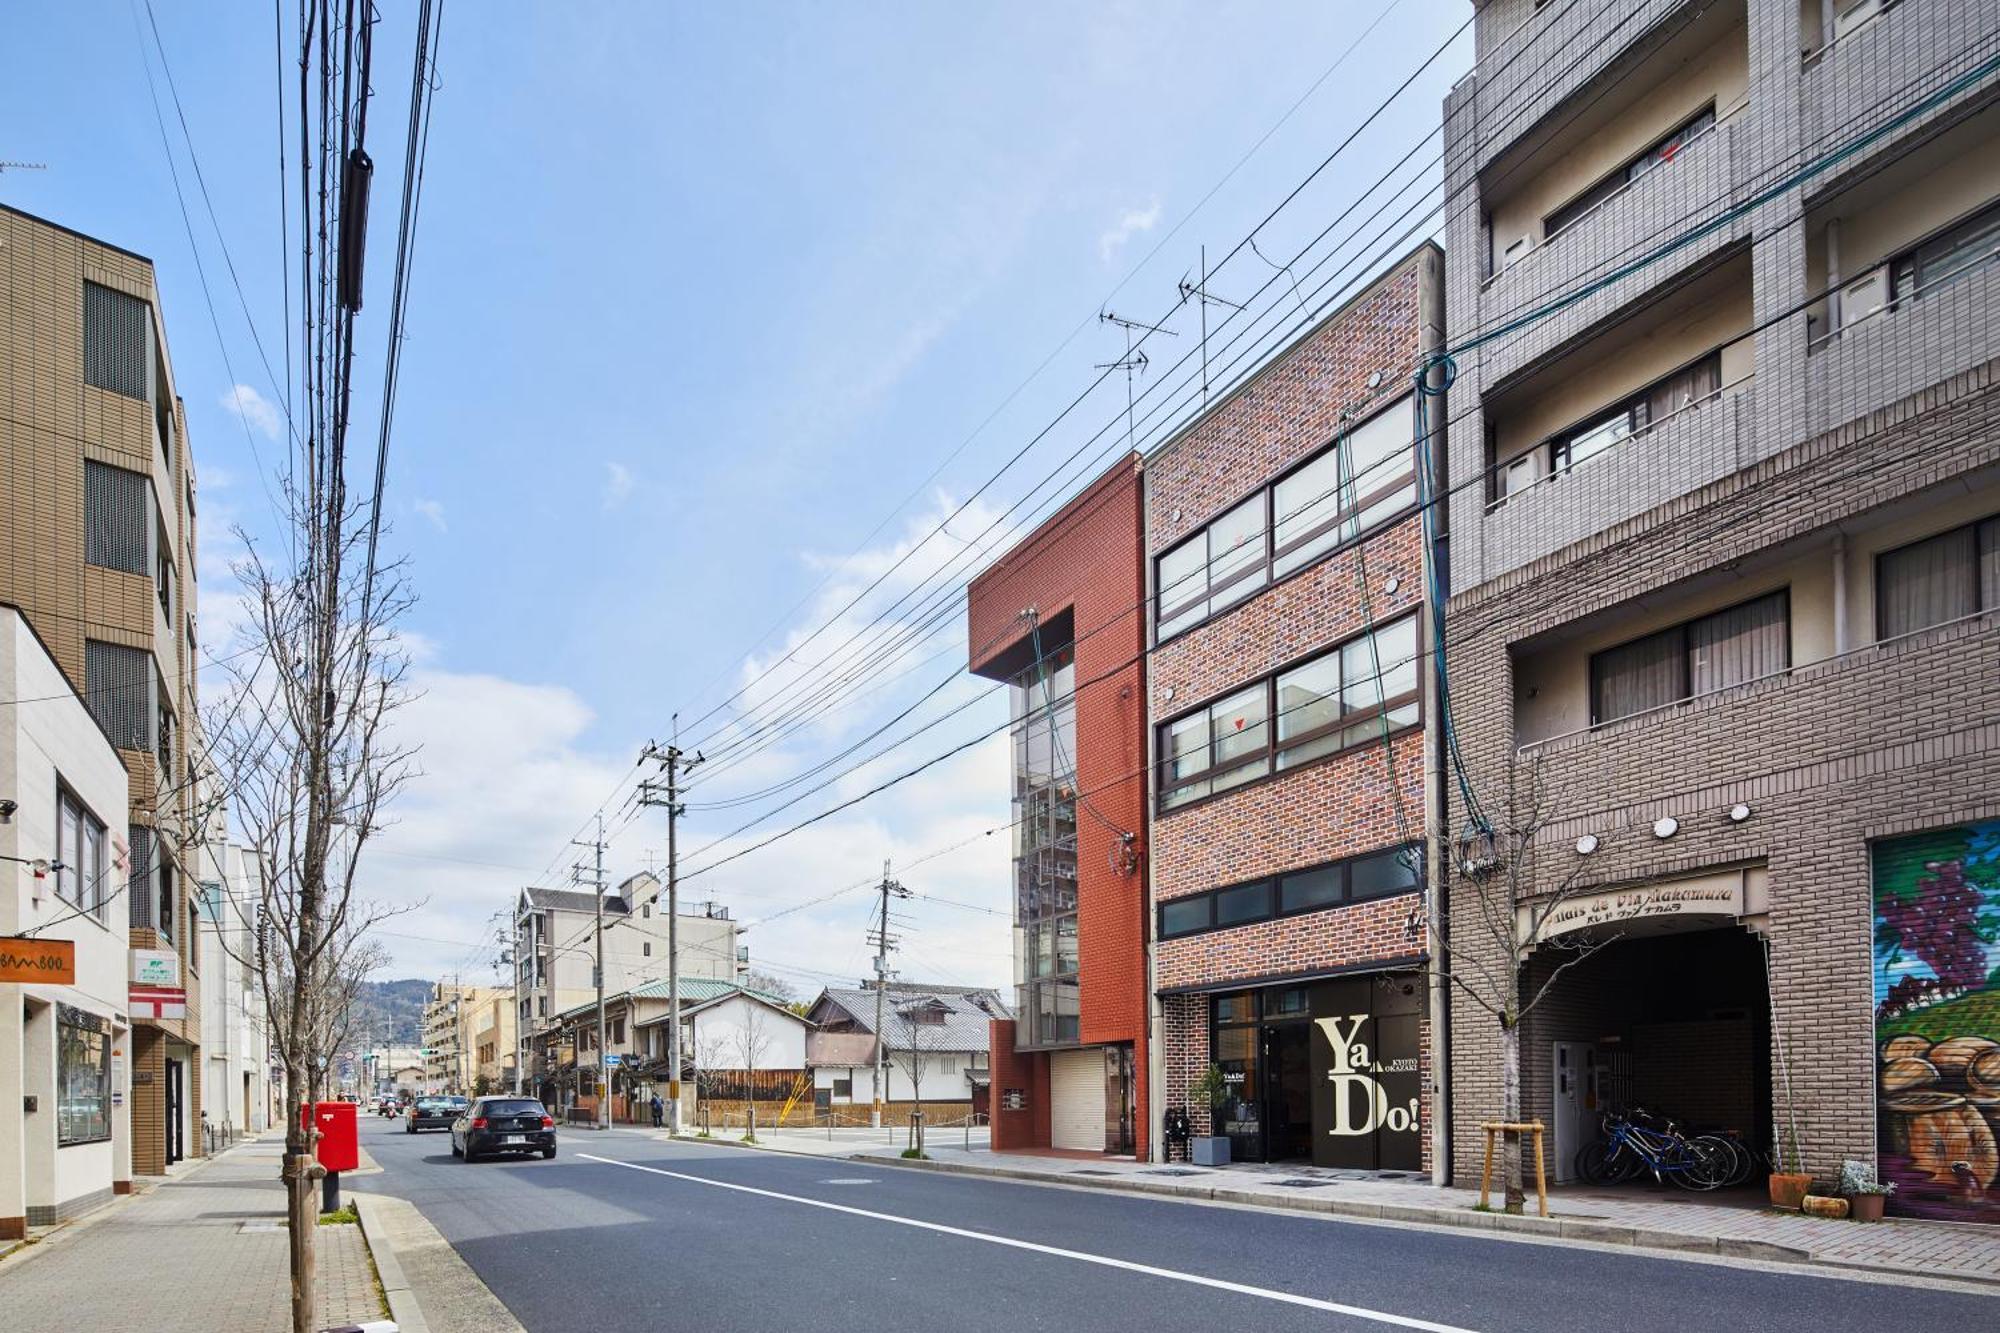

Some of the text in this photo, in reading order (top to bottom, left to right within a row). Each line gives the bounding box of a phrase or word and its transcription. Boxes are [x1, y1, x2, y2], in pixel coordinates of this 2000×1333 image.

[1592, 899, 1609, 911] de
[1616, 894, 1641, 908] Vin
[0, 953, 63, 971] BAMBOO
[1314, 1014, 1371, 1074] Ya
[1327, 1074, 1420, 1136] Do!
